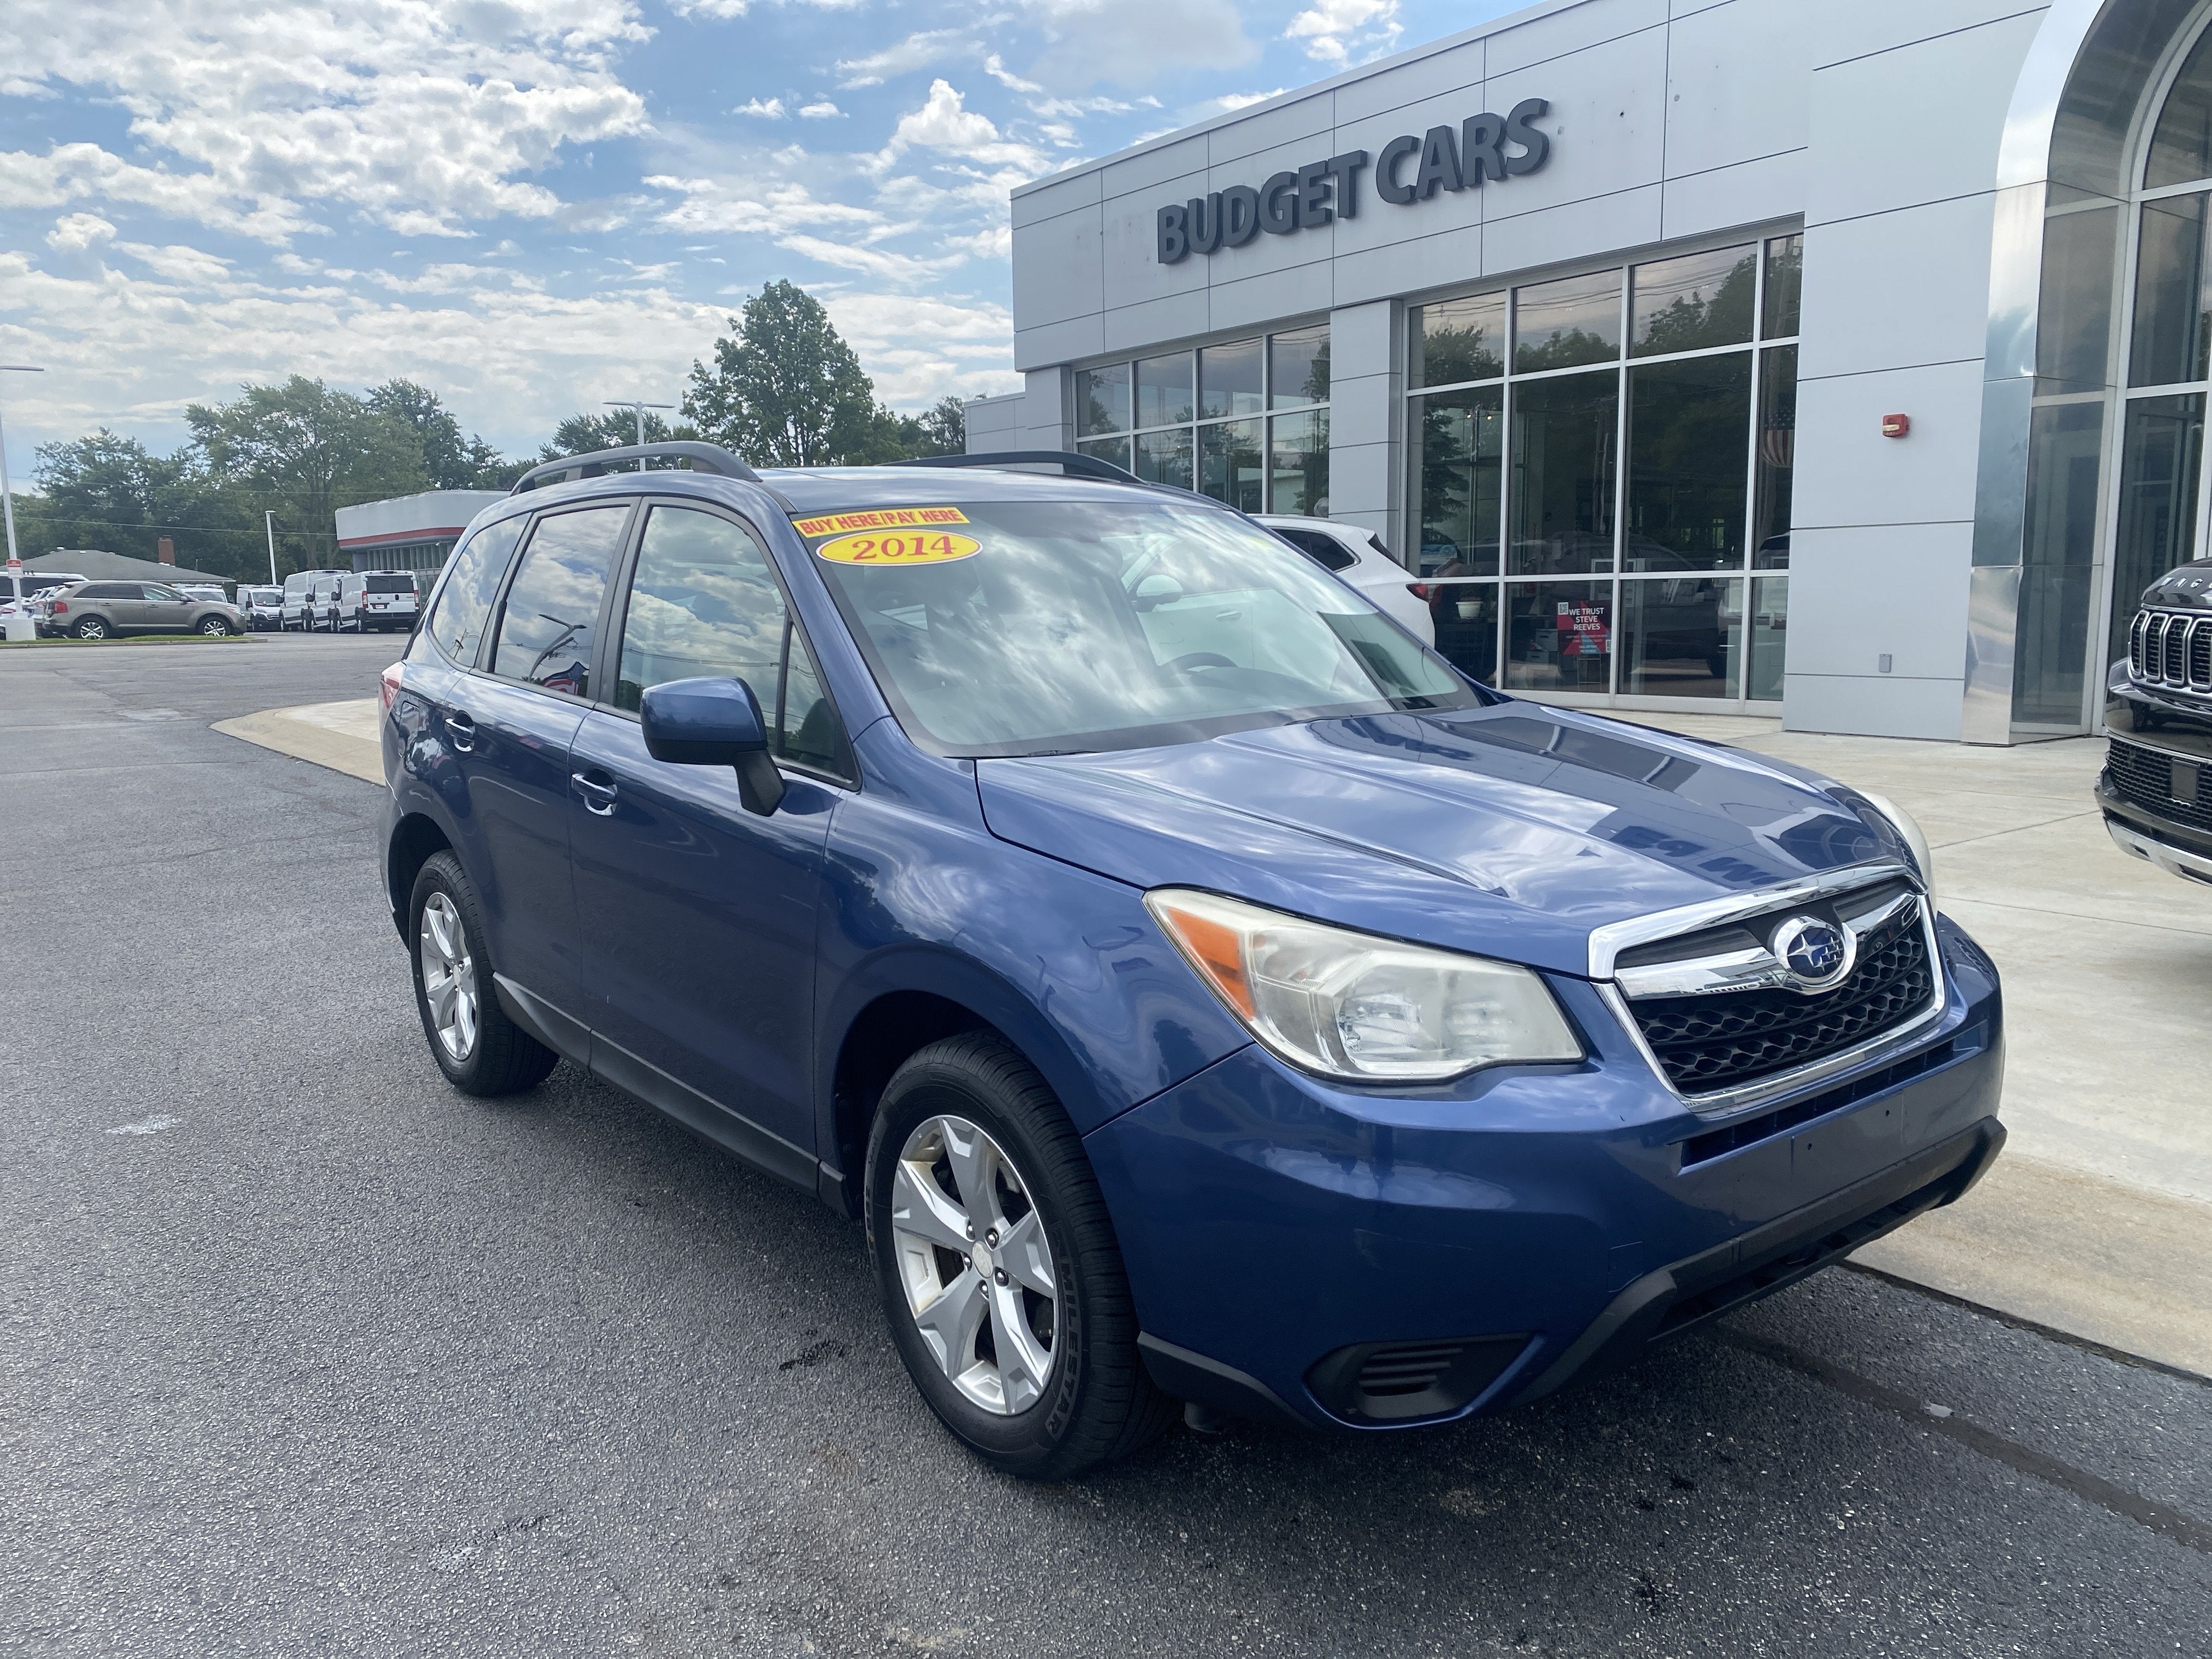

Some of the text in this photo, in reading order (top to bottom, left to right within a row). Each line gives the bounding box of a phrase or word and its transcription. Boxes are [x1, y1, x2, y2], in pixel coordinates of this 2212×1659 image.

[1158, 98, 1550, 264] BUDGET CARS
[799, 509, 963, 534] BUY HERE/PAY HERE
[852, 536, 957, 560] 2014
[2162, 577, 2212, 589] WAG
[1048, 1263, 1079, 1436] MILESTAR
